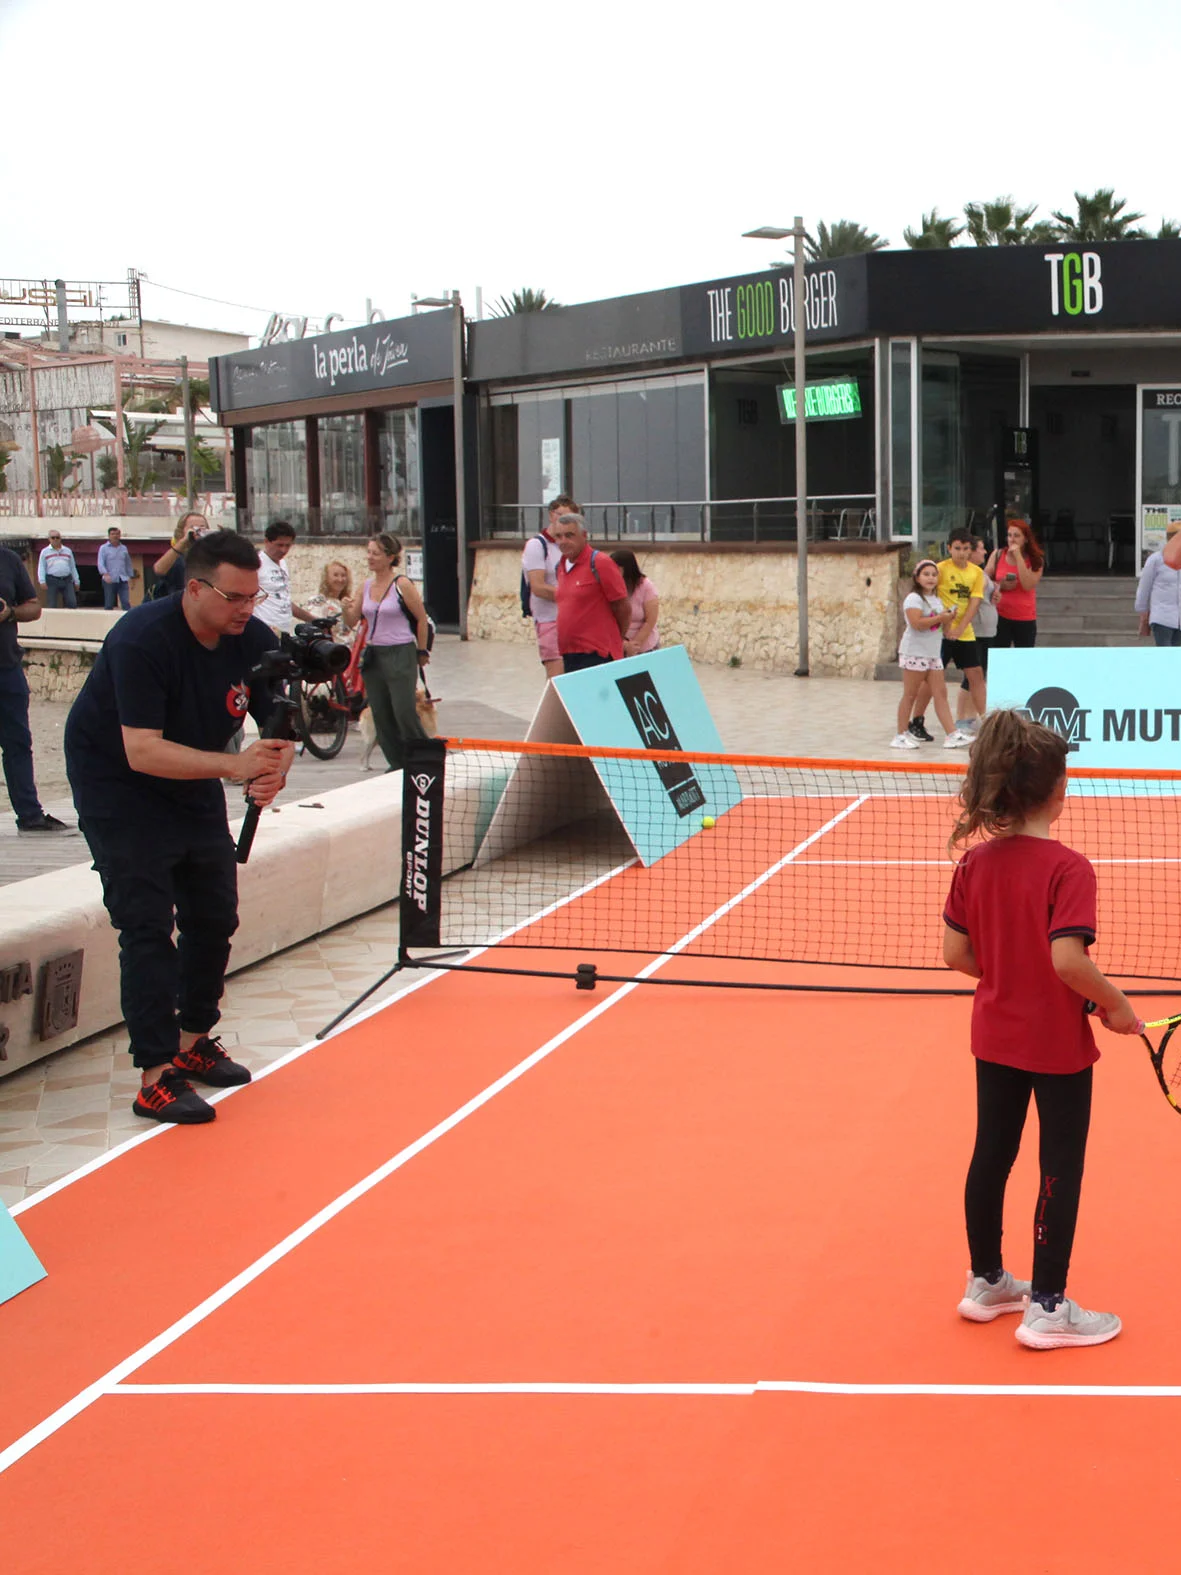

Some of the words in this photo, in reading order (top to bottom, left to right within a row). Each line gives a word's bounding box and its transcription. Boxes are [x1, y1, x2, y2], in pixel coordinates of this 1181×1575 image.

[707, 287, 733, 342] THE
[736, 281, 774, 339] GOOD
[1044, 252, 1103, 316] TGB
[313, 343, 327, 380] la
[329, 336, 368, 386] perla
[633, 691, 670, 746] AC
[414, 795, 430, 912] DUNLOP
